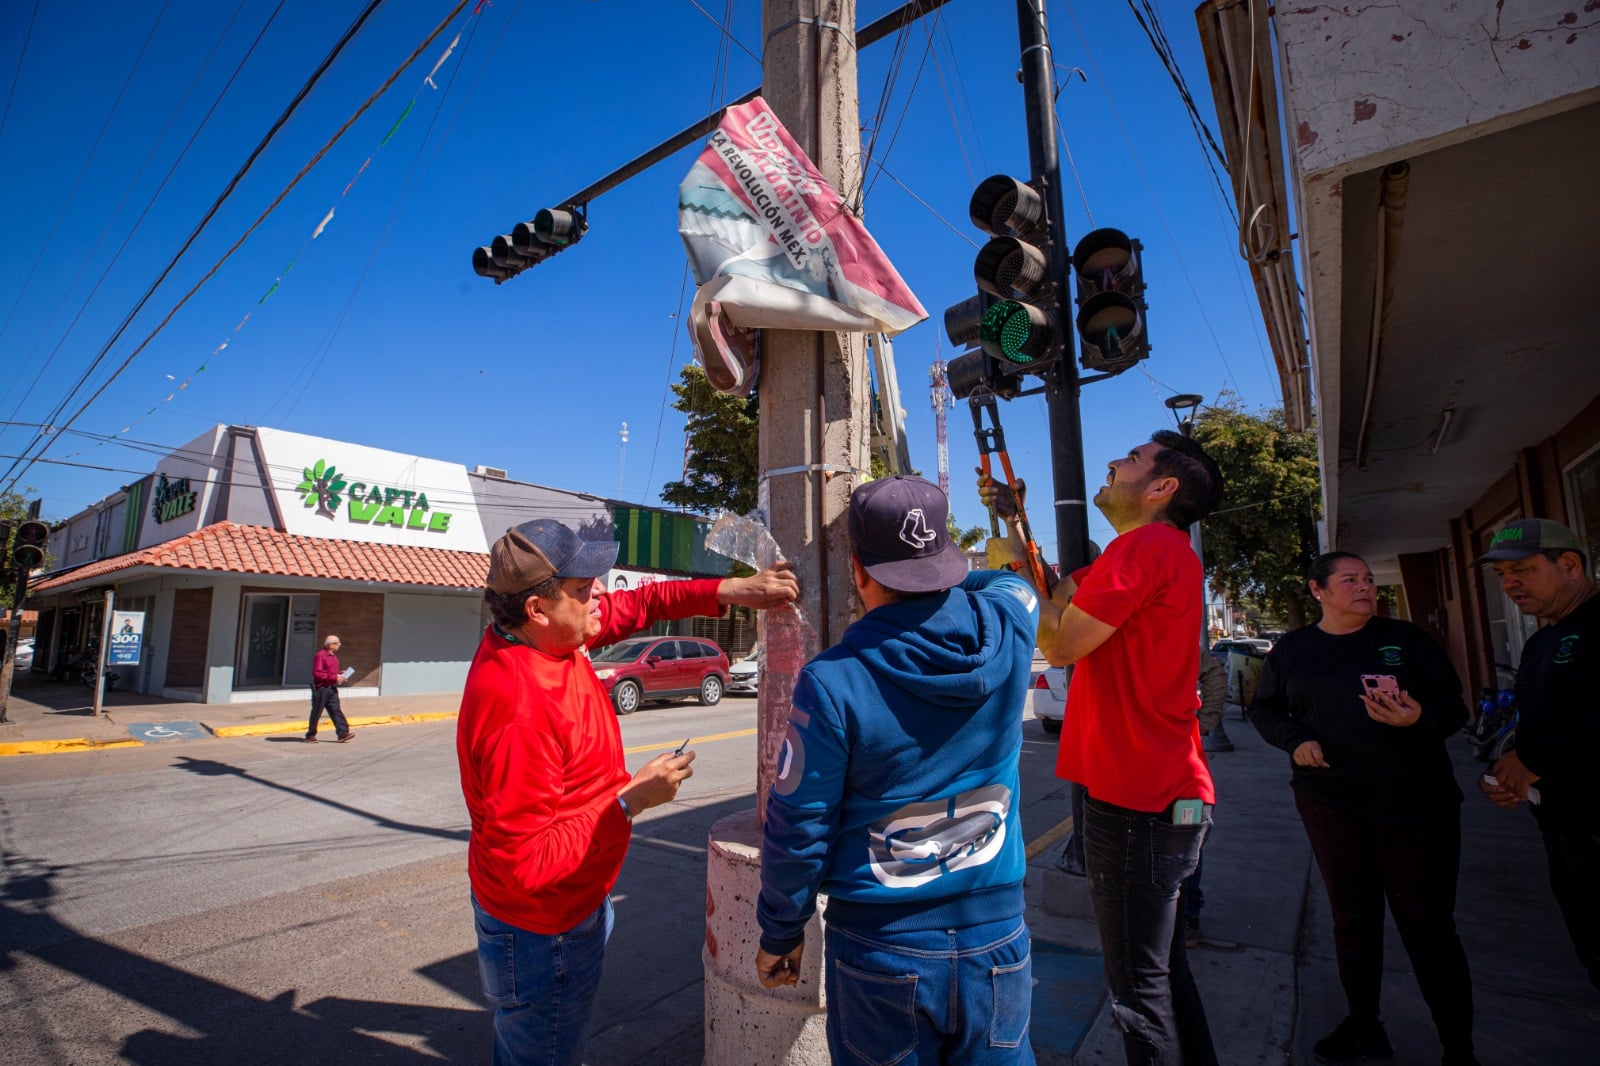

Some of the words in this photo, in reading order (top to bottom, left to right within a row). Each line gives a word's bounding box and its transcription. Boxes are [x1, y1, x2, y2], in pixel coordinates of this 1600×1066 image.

[711, 131, 726, 147] LA
[722, 146, 785, 231] REVOLUCIÓN
[779, 227, 807, 265] MEX.
[747, 150, 823, 244] ALUMINIO
[161, 492, 197, 522] VALE
[348, 482, 430, 510] CAPTA
[347, 500, 453, 532] VALE
